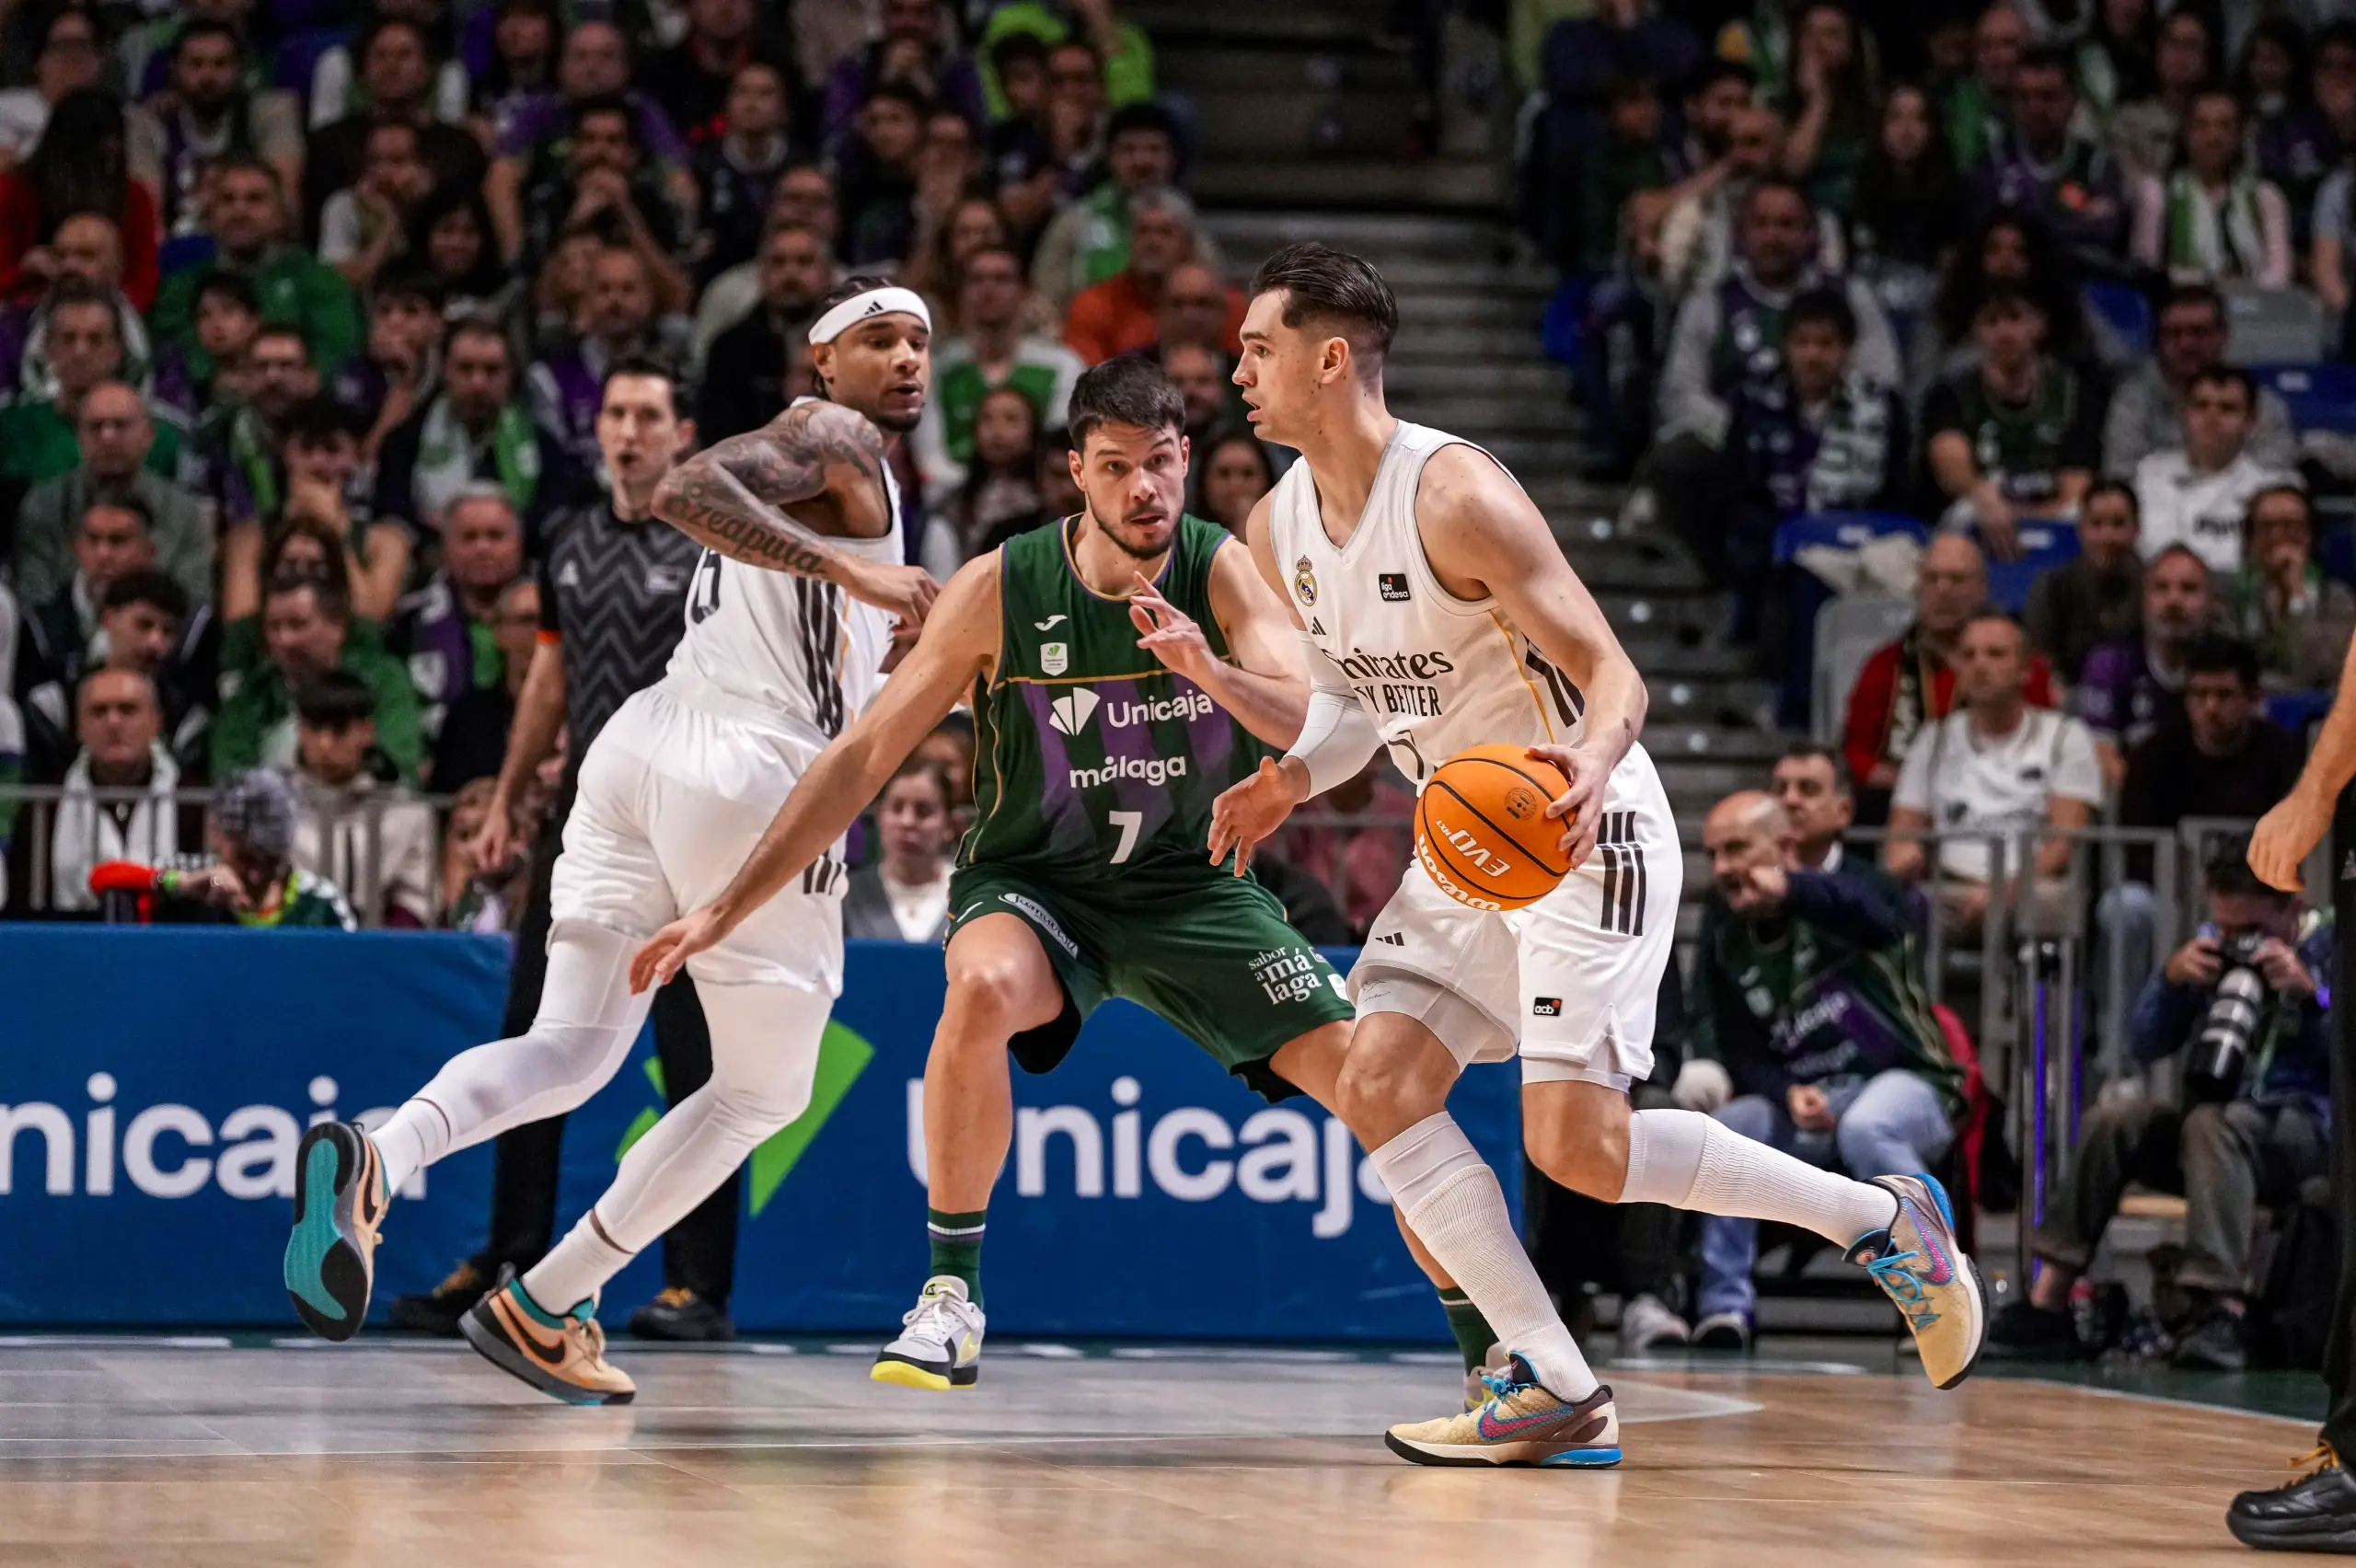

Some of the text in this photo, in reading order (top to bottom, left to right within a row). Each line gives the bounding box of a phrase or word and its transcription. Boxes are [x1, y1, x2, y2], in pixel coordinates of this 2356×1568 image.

[1382, 590, 1409, 599] endesa
[1107, 688, 1214, 728] Unicaja
[1381, 684, 1442, 717] BETTER
[1108, 810, 1142, 864] 7
[1448, 829, 1511, 877] EVO
[1248, 946, 1287, 970] sabor
[1253, 947, 1314, 983] a má
[1261, 972, 1322, 1005] laga
[1534, 1004, 1554, 1015] acb
